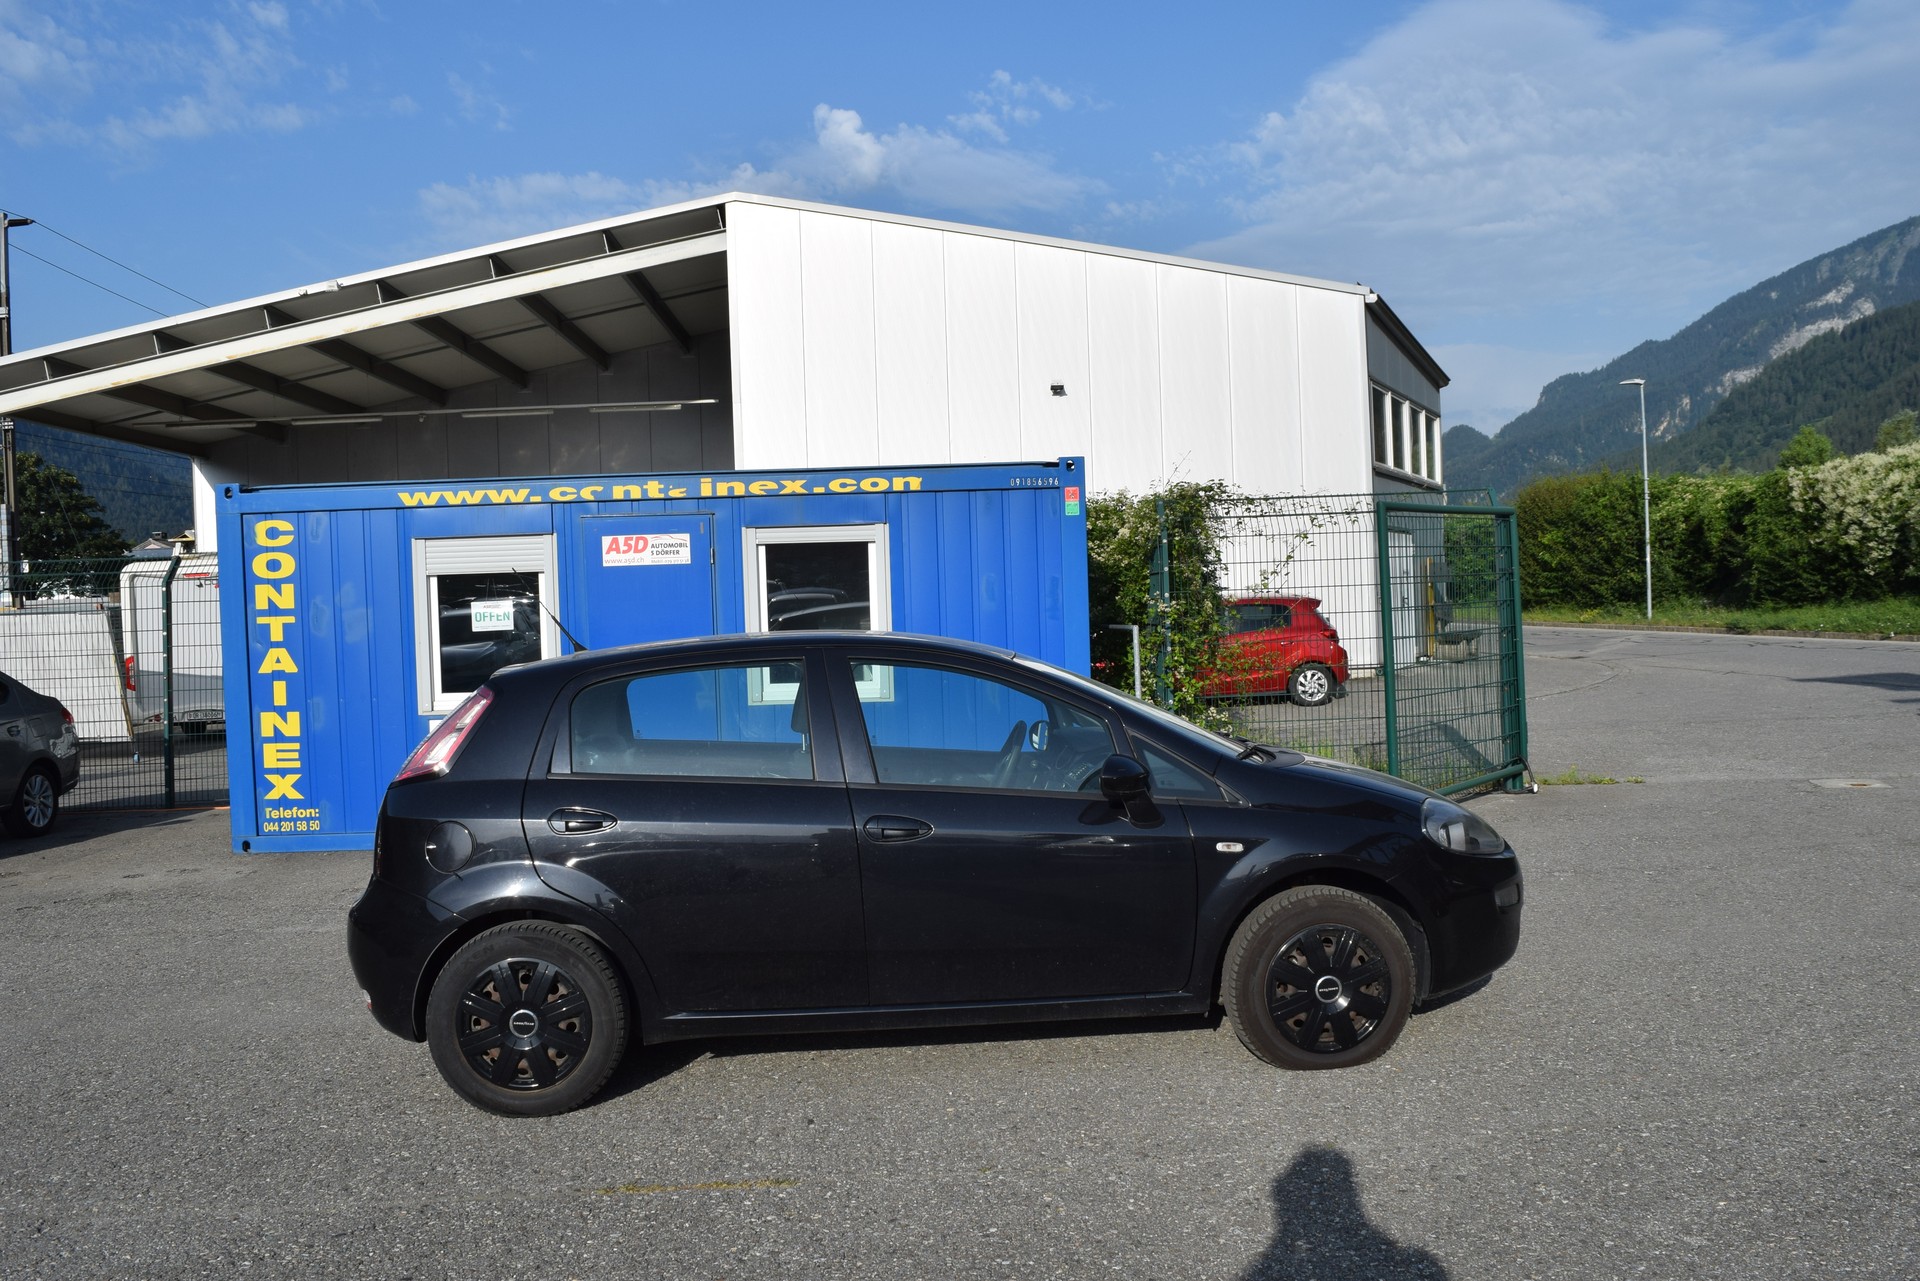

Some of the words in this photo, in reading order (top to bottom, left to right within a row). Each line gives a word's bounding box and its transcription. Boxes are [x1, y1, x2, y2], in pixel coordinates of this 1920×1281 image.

[605, 536, 649, 555] A5D
[474, 611, 511, 622] OFFEN
[252, 520, 304, 799] CONTAINEX
[265, 806, 320, 819] Telefon:
[263, 821, 279, 832] 044
[280, 821, 295, 832] 201
[296, 820, 308, 832] 58
[309, 820, 320, 831] 50
